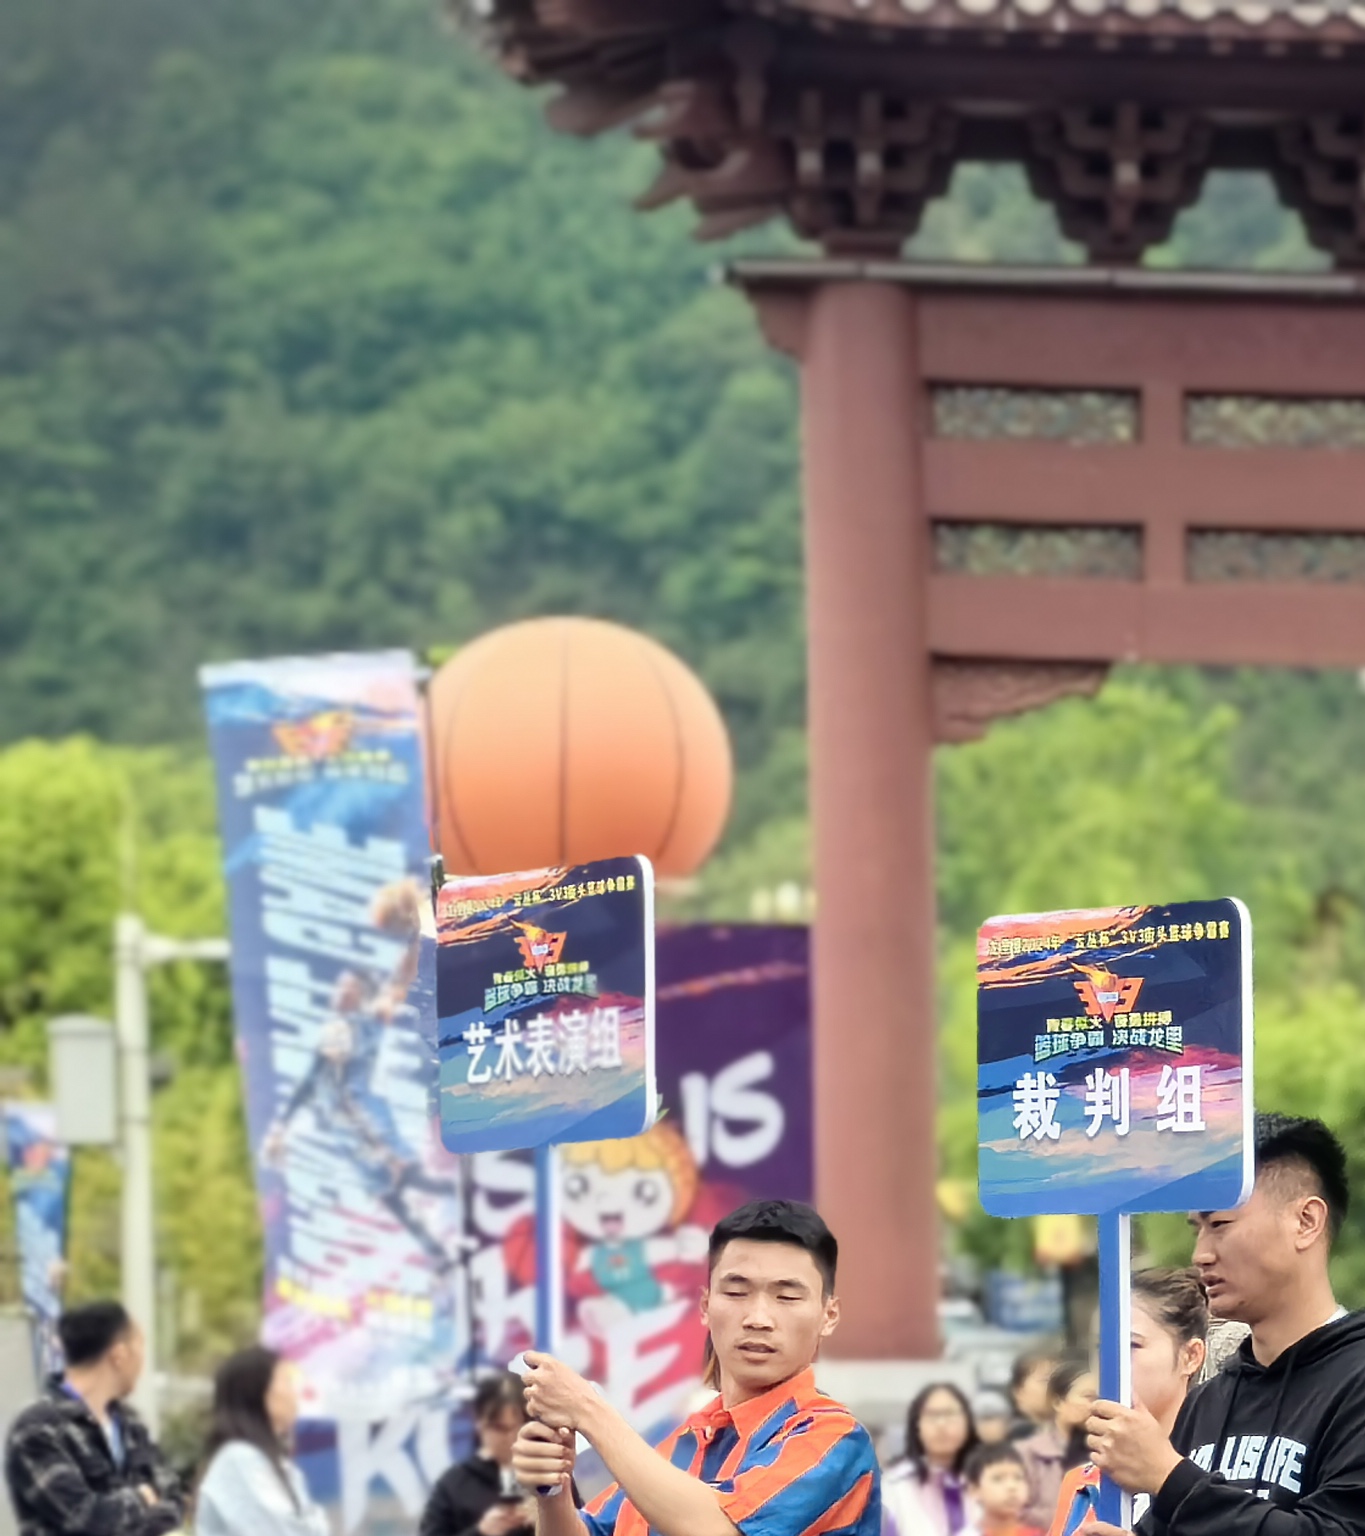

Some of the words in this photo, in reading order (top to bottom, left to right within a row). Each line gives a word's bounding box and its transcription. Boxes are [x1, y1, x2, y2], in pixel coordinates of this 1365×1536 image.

[463, 1006, 622, 1084] 艺术表演组
[1012, 1065, 1206, 1141] 裁判组
